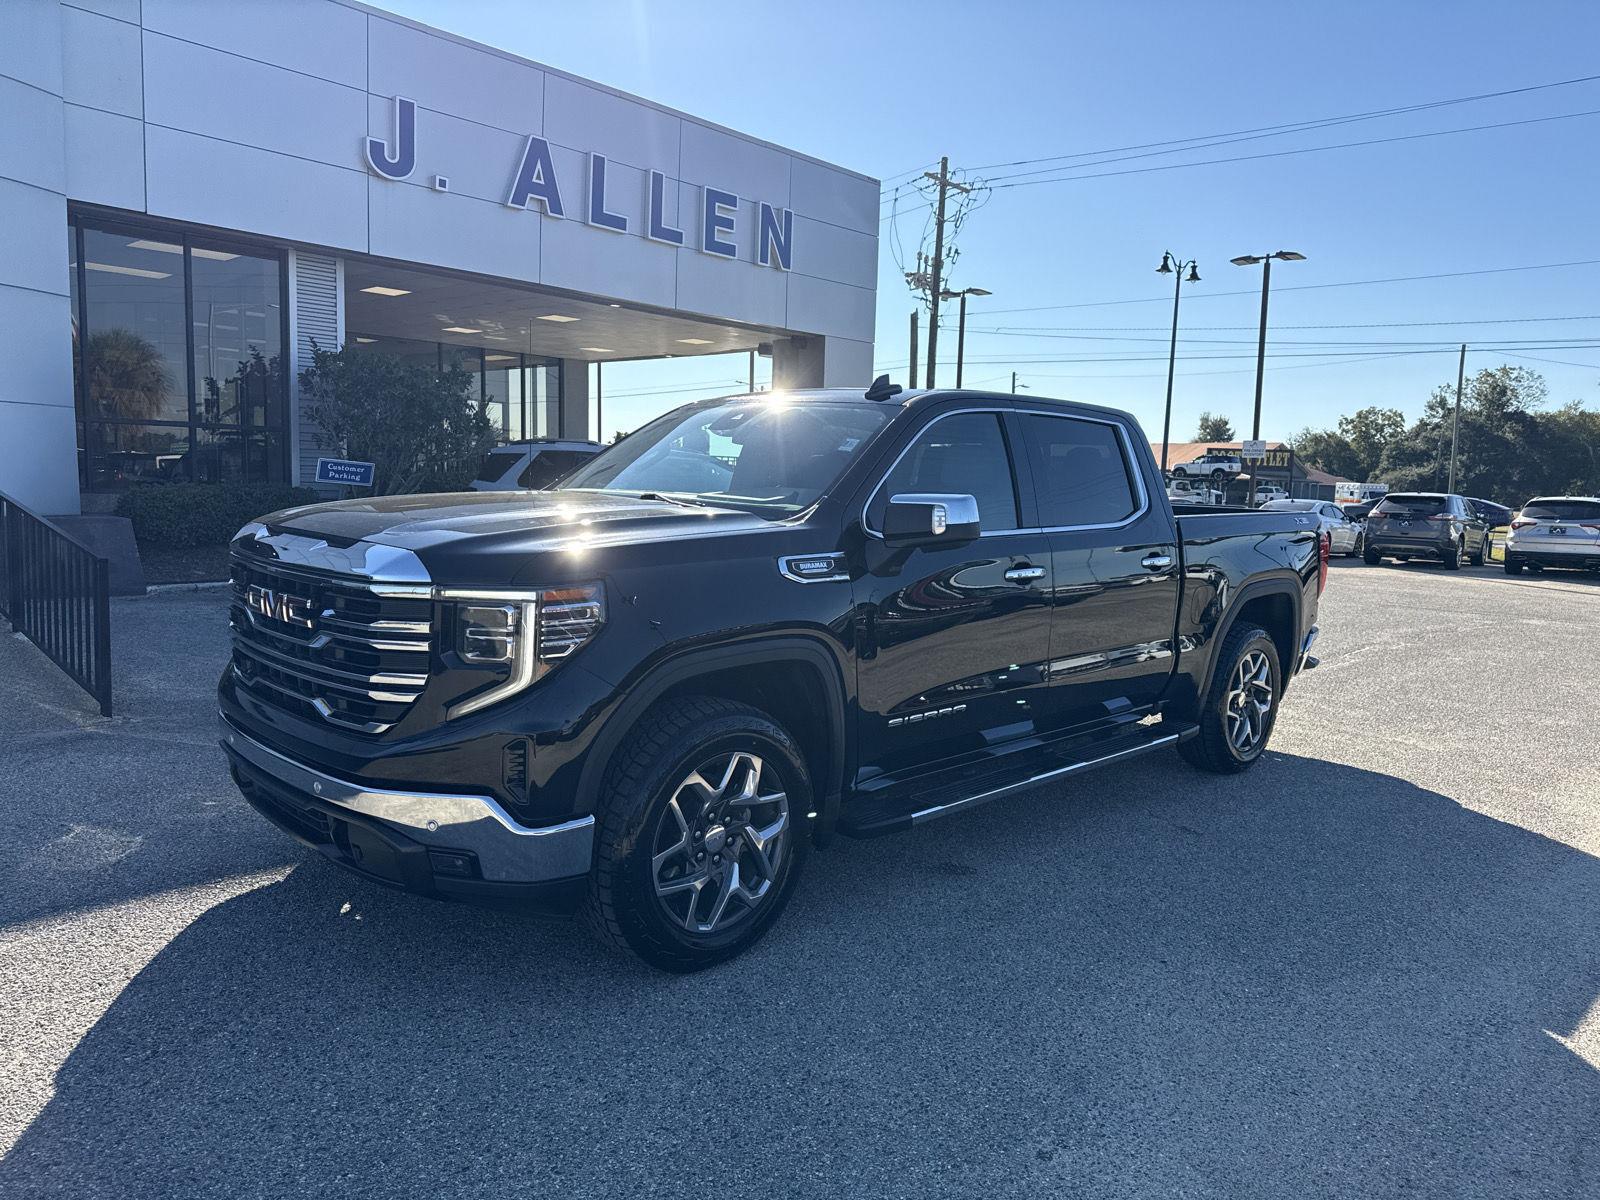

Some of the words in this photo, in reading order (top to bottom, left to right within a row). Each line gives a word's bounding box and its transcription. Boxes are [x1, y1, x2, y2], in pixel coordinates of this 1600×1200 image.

[365, 96, 449, 192] J.
[507, 134, 794, 272] ALLEN
[1247, 452, 1290, 466] TLET
[328, 463, 365, 473] Customer
[329, 471, 361, 481] Parking
[800, 562, 828, 570] DURAMAX
[246, 584, 313, 629] GMC
